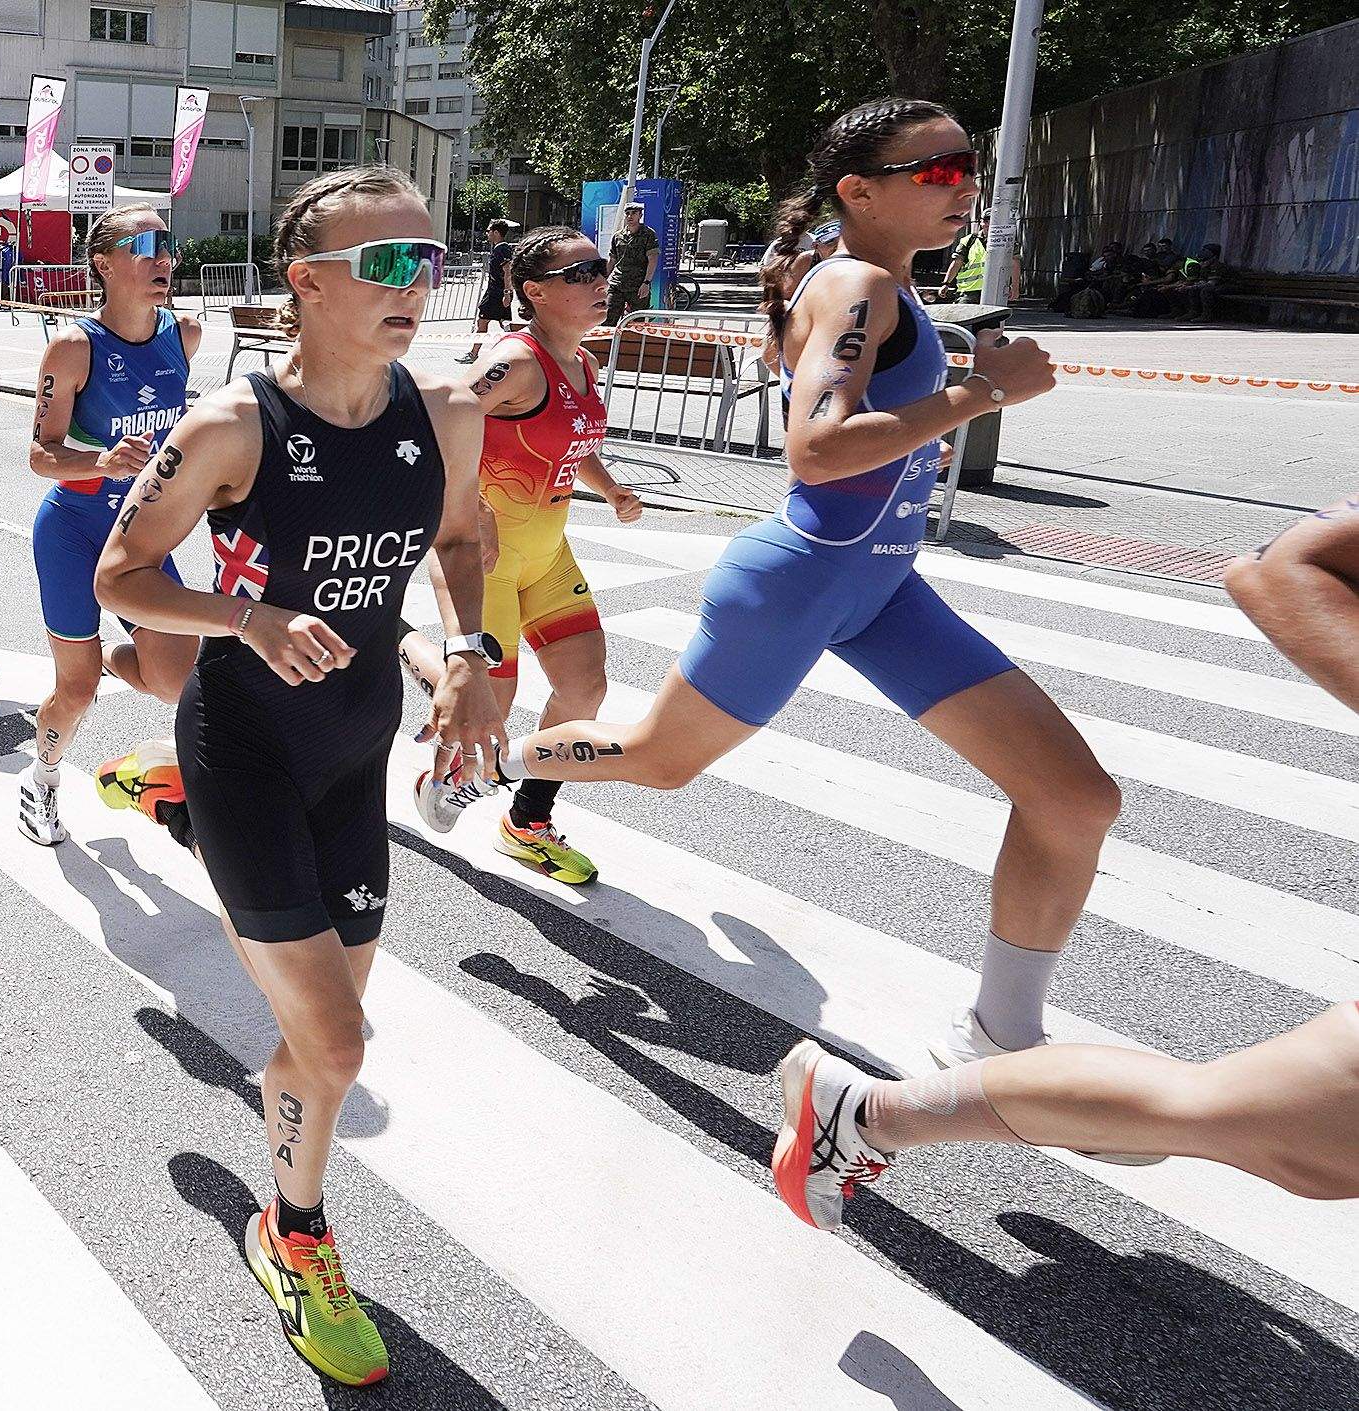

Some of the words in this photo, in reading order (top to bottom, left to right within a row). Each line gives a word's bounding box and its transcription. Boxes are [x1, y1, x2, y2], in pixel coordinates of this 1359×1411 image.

[832, 299, 870, 362] 16
[41, 374, 56, 399] 2
[156, 445, 183, 480] 3
[288, 473, 324, 482] Triathlon
[292, 465, 317, 474] World
[117, 503, 141, 535] A
[302, 528, 424, 572] PRICE
[312, 575, 391, 612] GBR
[278, 1090, 304, 1125] 3
[276, 1145, 295, 1169] A
